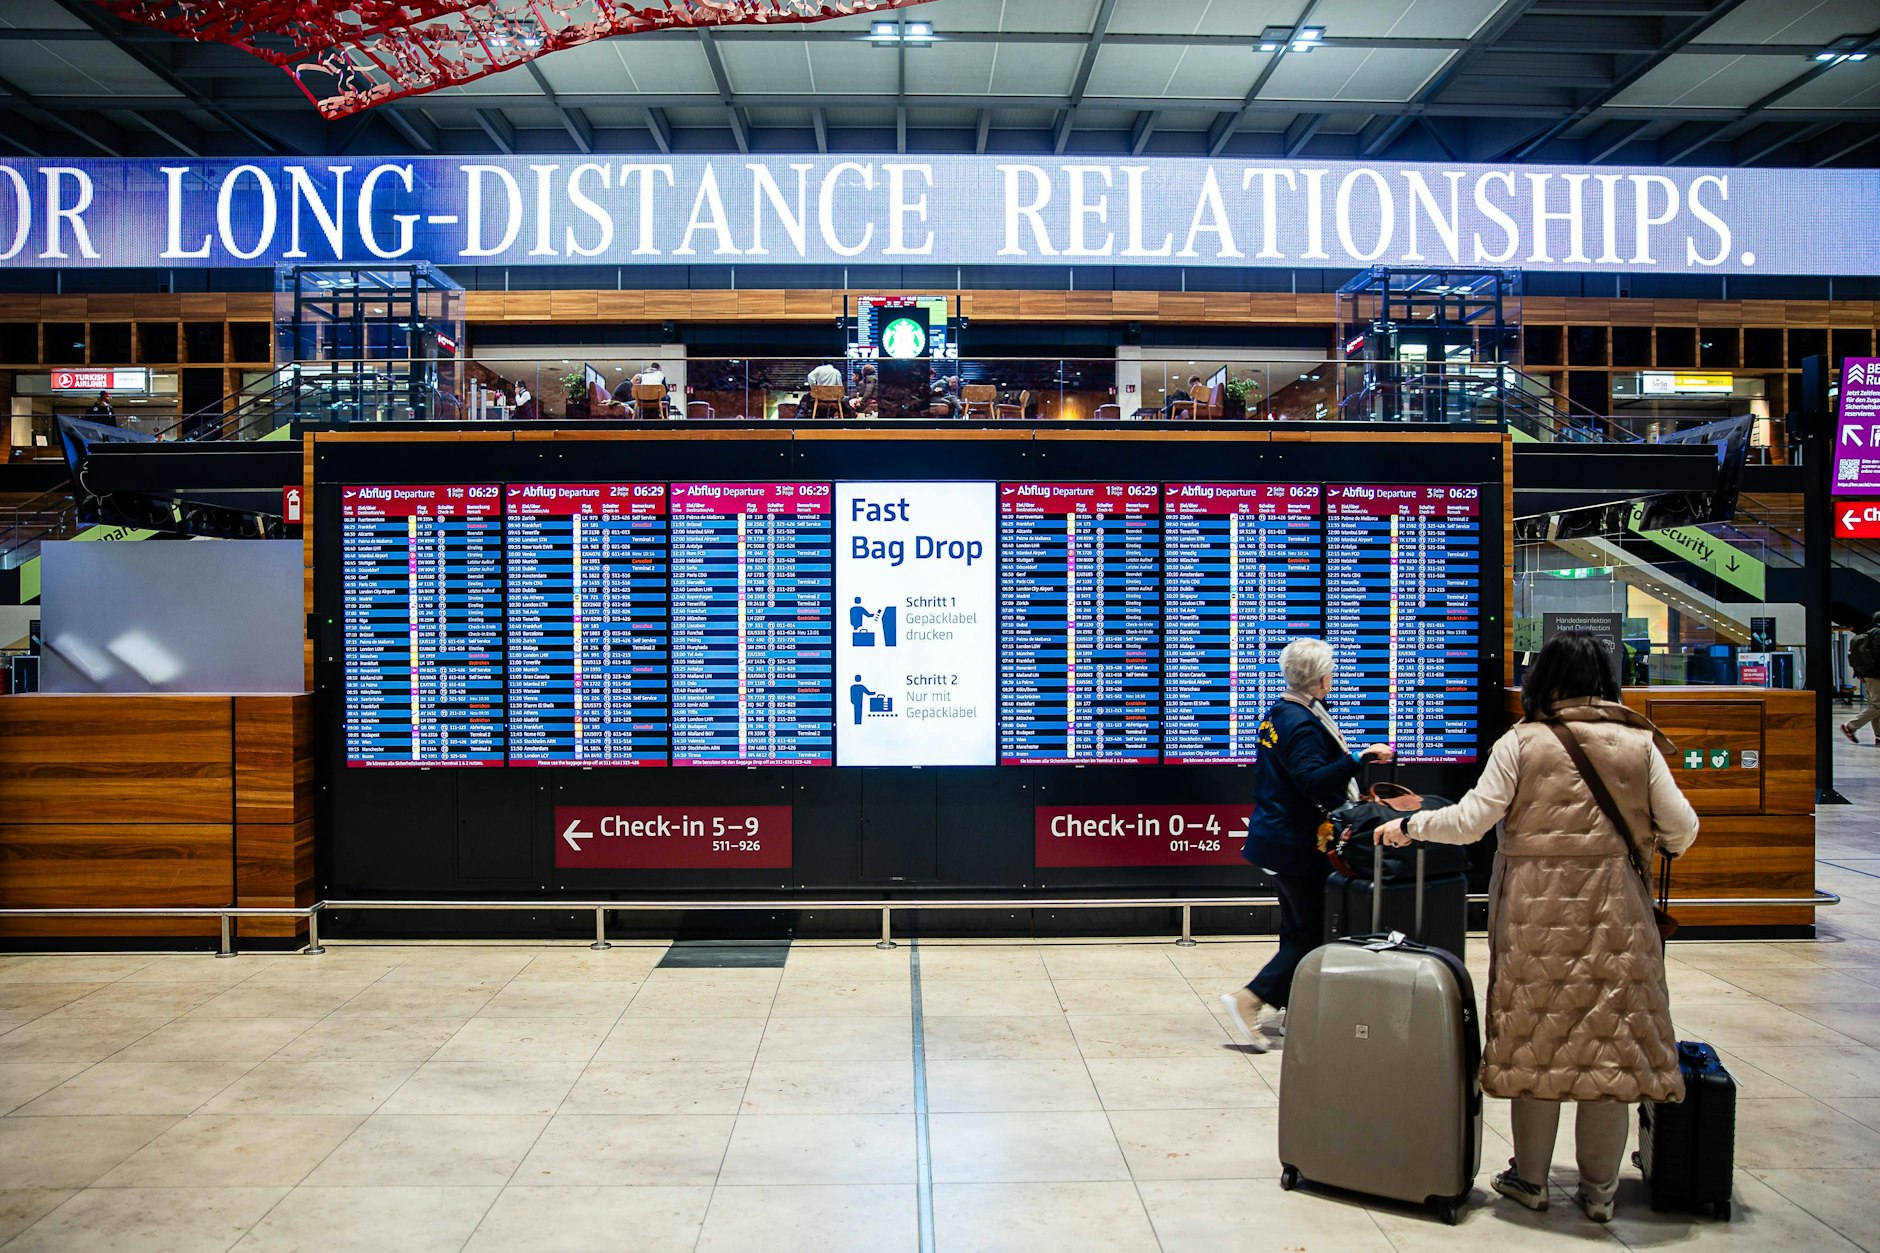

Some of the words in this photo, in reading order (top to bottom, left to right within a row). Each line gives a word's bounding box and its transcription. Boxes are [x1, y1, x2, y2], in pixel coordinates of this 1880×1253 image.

[159, 162, 934, 259] LONG-DISTANCE
[996, 163, 1756, 268] RELATIONSHIPS.
[358, 488, 391, 500] Abflug
[394, 489, 434, 499] Departure
[447, 488, 451, 497] 1
[469, 488, 498, 497] 06:29
[523, 487, 556, 498] Abflug
[558, 488, 599, 498] Departure
[610, 487, 616, 496] 2
[634, 487, 664, 496] 06:29
[688, 486, 720, 498] Abflug
[723, 488, 764, 497] Departure
[776, 487, 781, 495] 3
[800, 486, 829, 495] 06:29
[1018, 486, 1050, 498] Abflug
[1053, 488, 1094, 497] Departure
[1106, 487, 1111, 495] 1
[1128, 486, 1157, 495] 06:29
[1181, 486, 1213, 498] Abflug
[1216, 488, 1256, 497] Departure
[1267, 487, 1273, 496] 2
[1290, 487, 1318, 496] 06:29
[1342, 488, 1374, 499] Abflug
[1377, 489, 1416, 498] Departure
[1427, 489, 1432, 498] 3
[1450, 489, 1477, 498] 06:29
[852, 498, 910, 522] Fast
[852, 536, 904, 566] Bag
[916, 536, 982, 566] Drop
[1661, 528, 1714, 562] ecurity
[906, 596, 947, 607] Schritt
[950, 598, 956, 606] 1
[906, 612, 976, 626] Gepäcklabel
[906, 629, 953, 640] drucken
[906, 674, 947, 685] Schritt
[950, 675, 958, 684] 2
[906, 692, 926, 701] Nur
[932, 690, 951, 701] mit
[906, 706, 976, 720] Gepäcklabel
[600, 815, 704, 836] Check-in
[1051, 814, 1160, 836] Check-in
